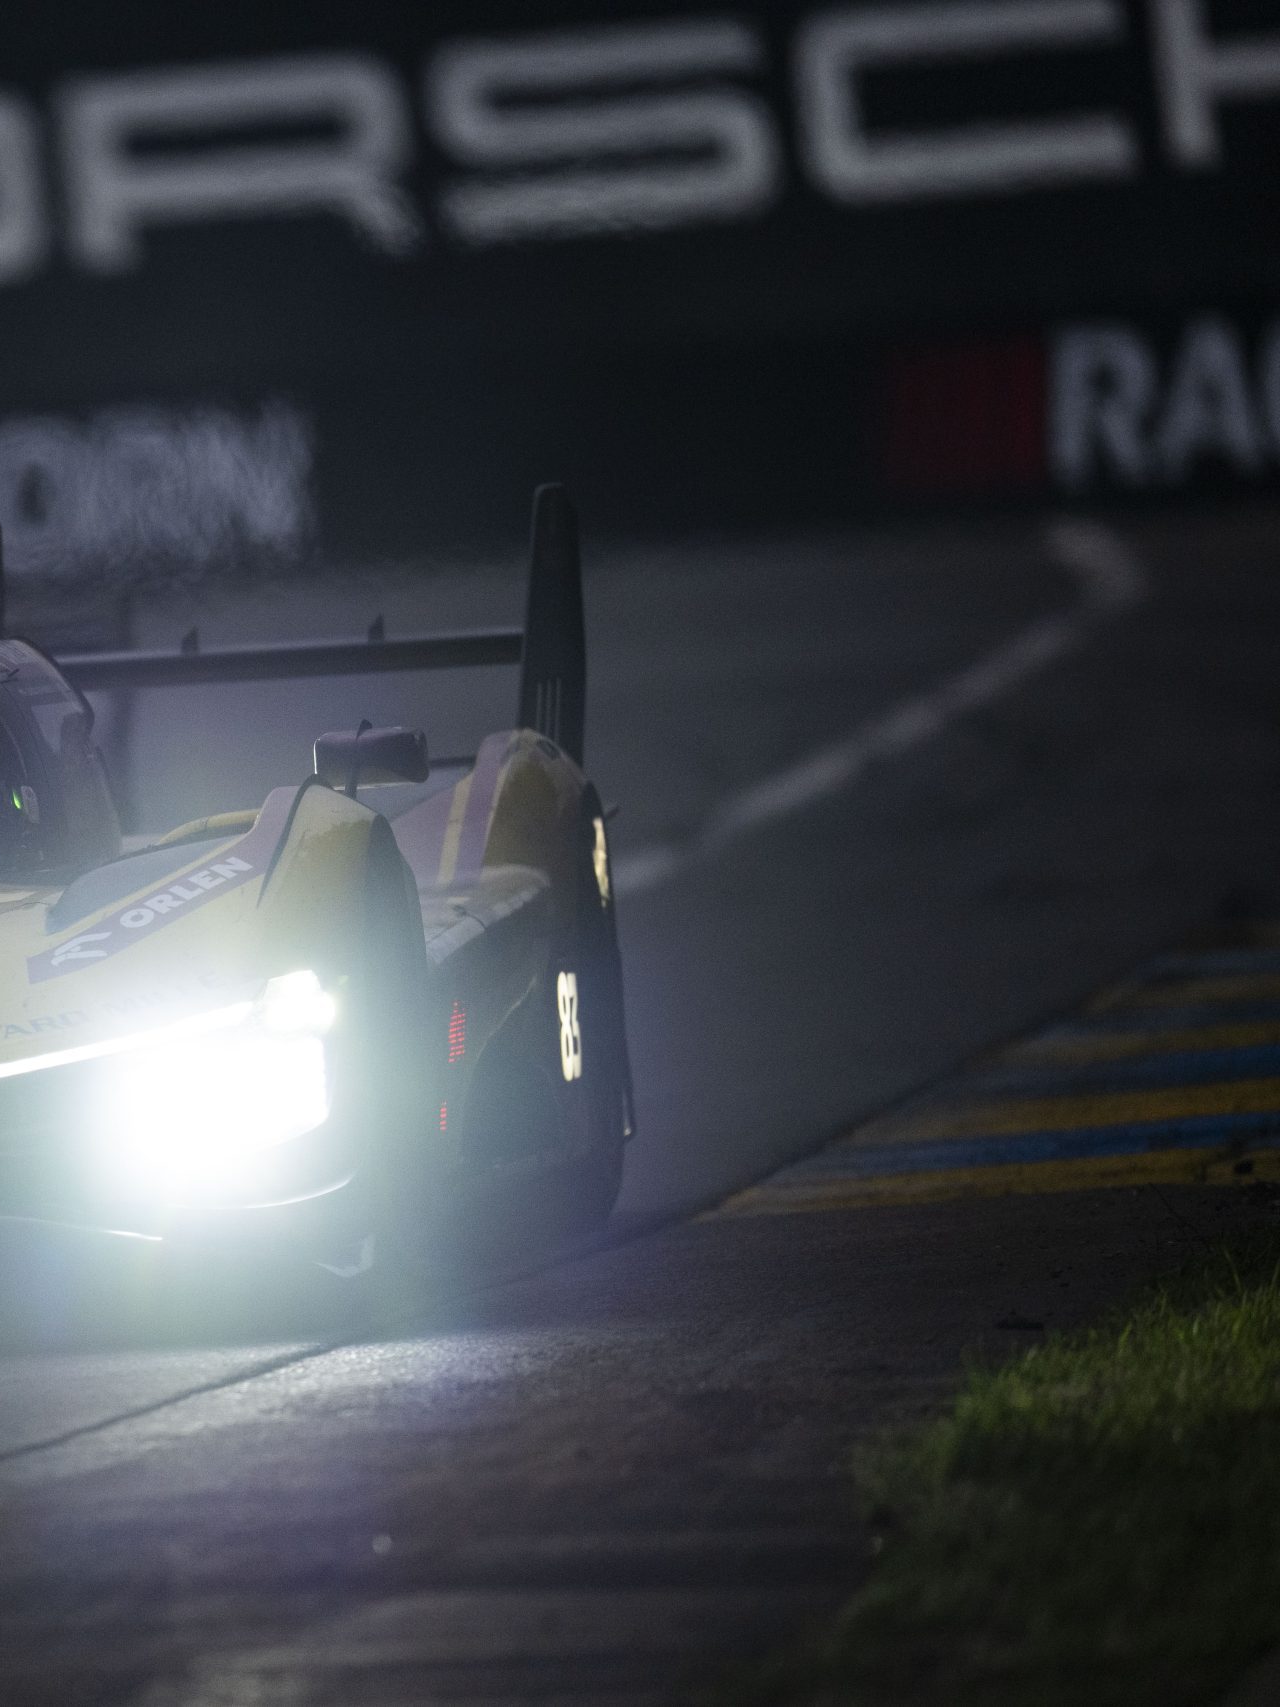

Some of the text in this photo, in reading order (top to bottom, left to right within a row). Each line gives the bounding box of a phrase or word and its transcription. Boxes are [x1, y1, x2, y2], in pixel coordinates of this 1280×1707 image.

[1050, 320, 1280, 482] RA
[120, 856, 253, 929] ORLEN
[557, 970, 582, 1081] 83
